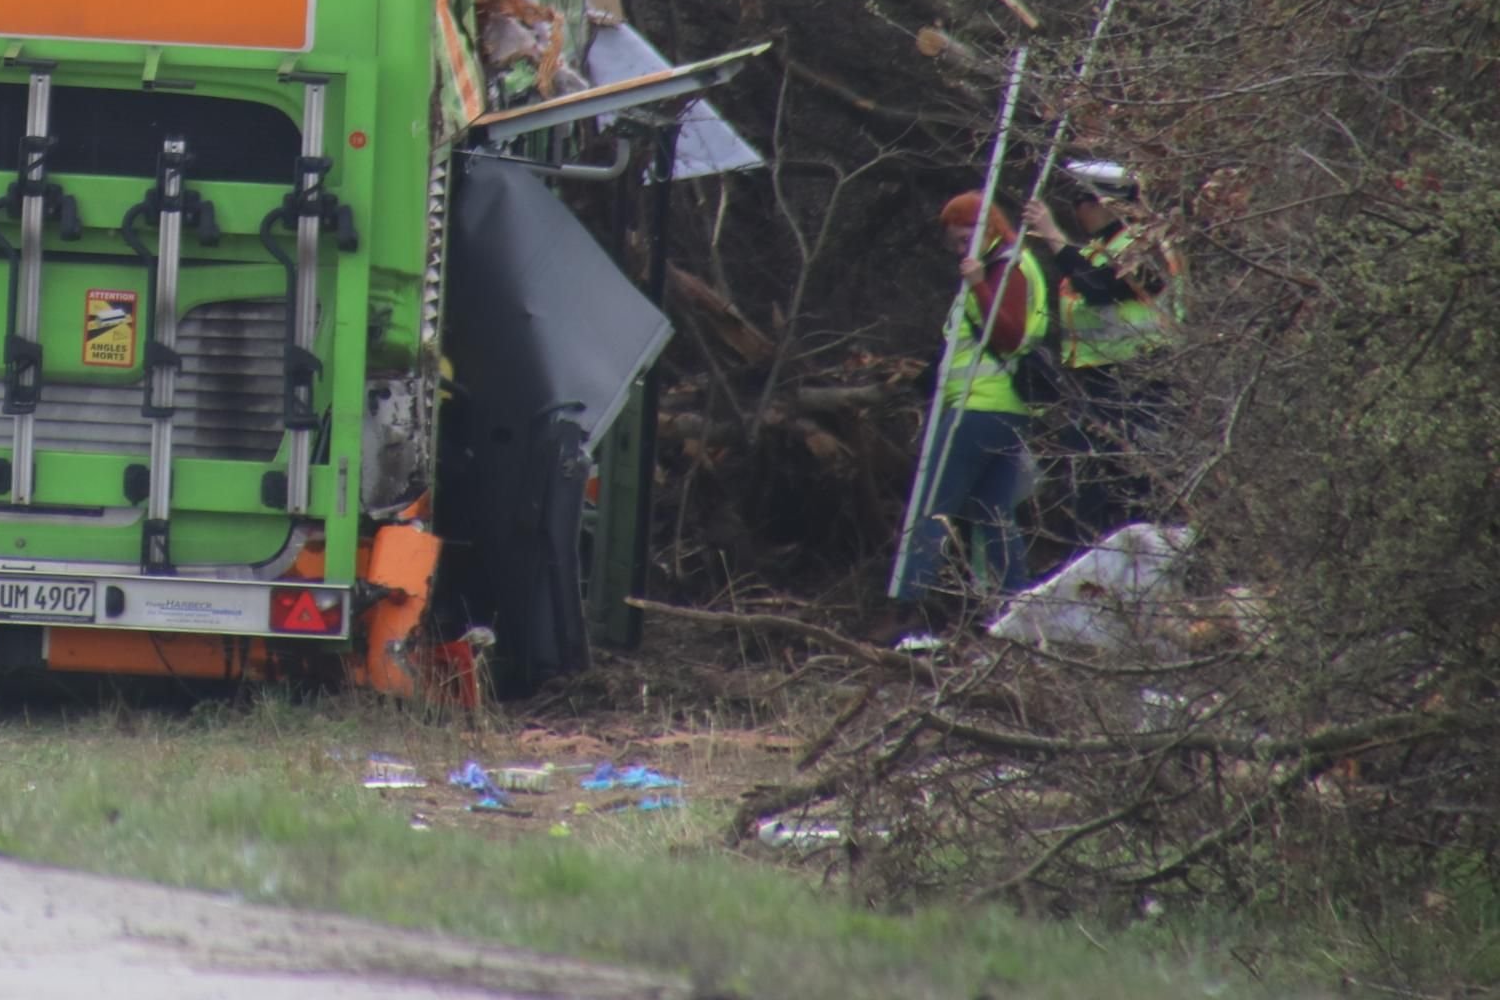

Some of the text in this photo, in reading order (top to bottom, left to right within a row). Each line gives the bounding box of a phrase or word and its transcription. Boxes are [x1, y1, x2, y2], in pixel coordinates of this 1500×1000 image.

[89, 291, 135, 301] ATTENTION
[91, 343, 127, 353] ANGLES
[92, 352, 125, 361] MORTS
[0, 584, 28, 609] UM
[34, 586, 90, 612] 4907
